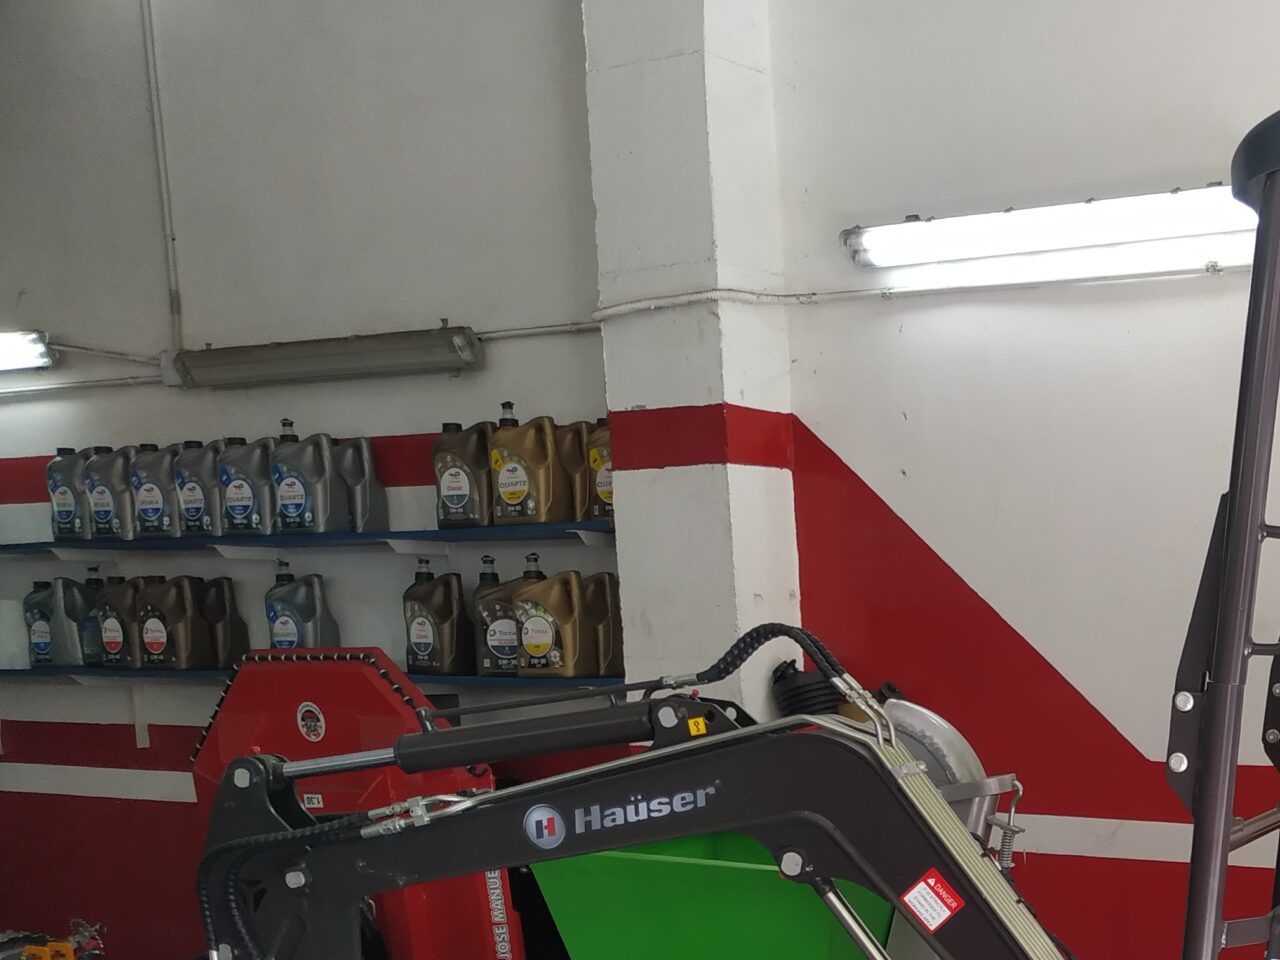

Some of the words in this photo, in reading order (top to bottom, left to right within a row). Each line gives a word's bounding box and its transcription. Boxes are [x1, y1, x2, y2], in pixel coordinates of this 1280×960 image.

[574, 785, 717, 835] Haüser
[485, 868, 508, 924] MANUE
[934, 883, 958, 909] DANGER
